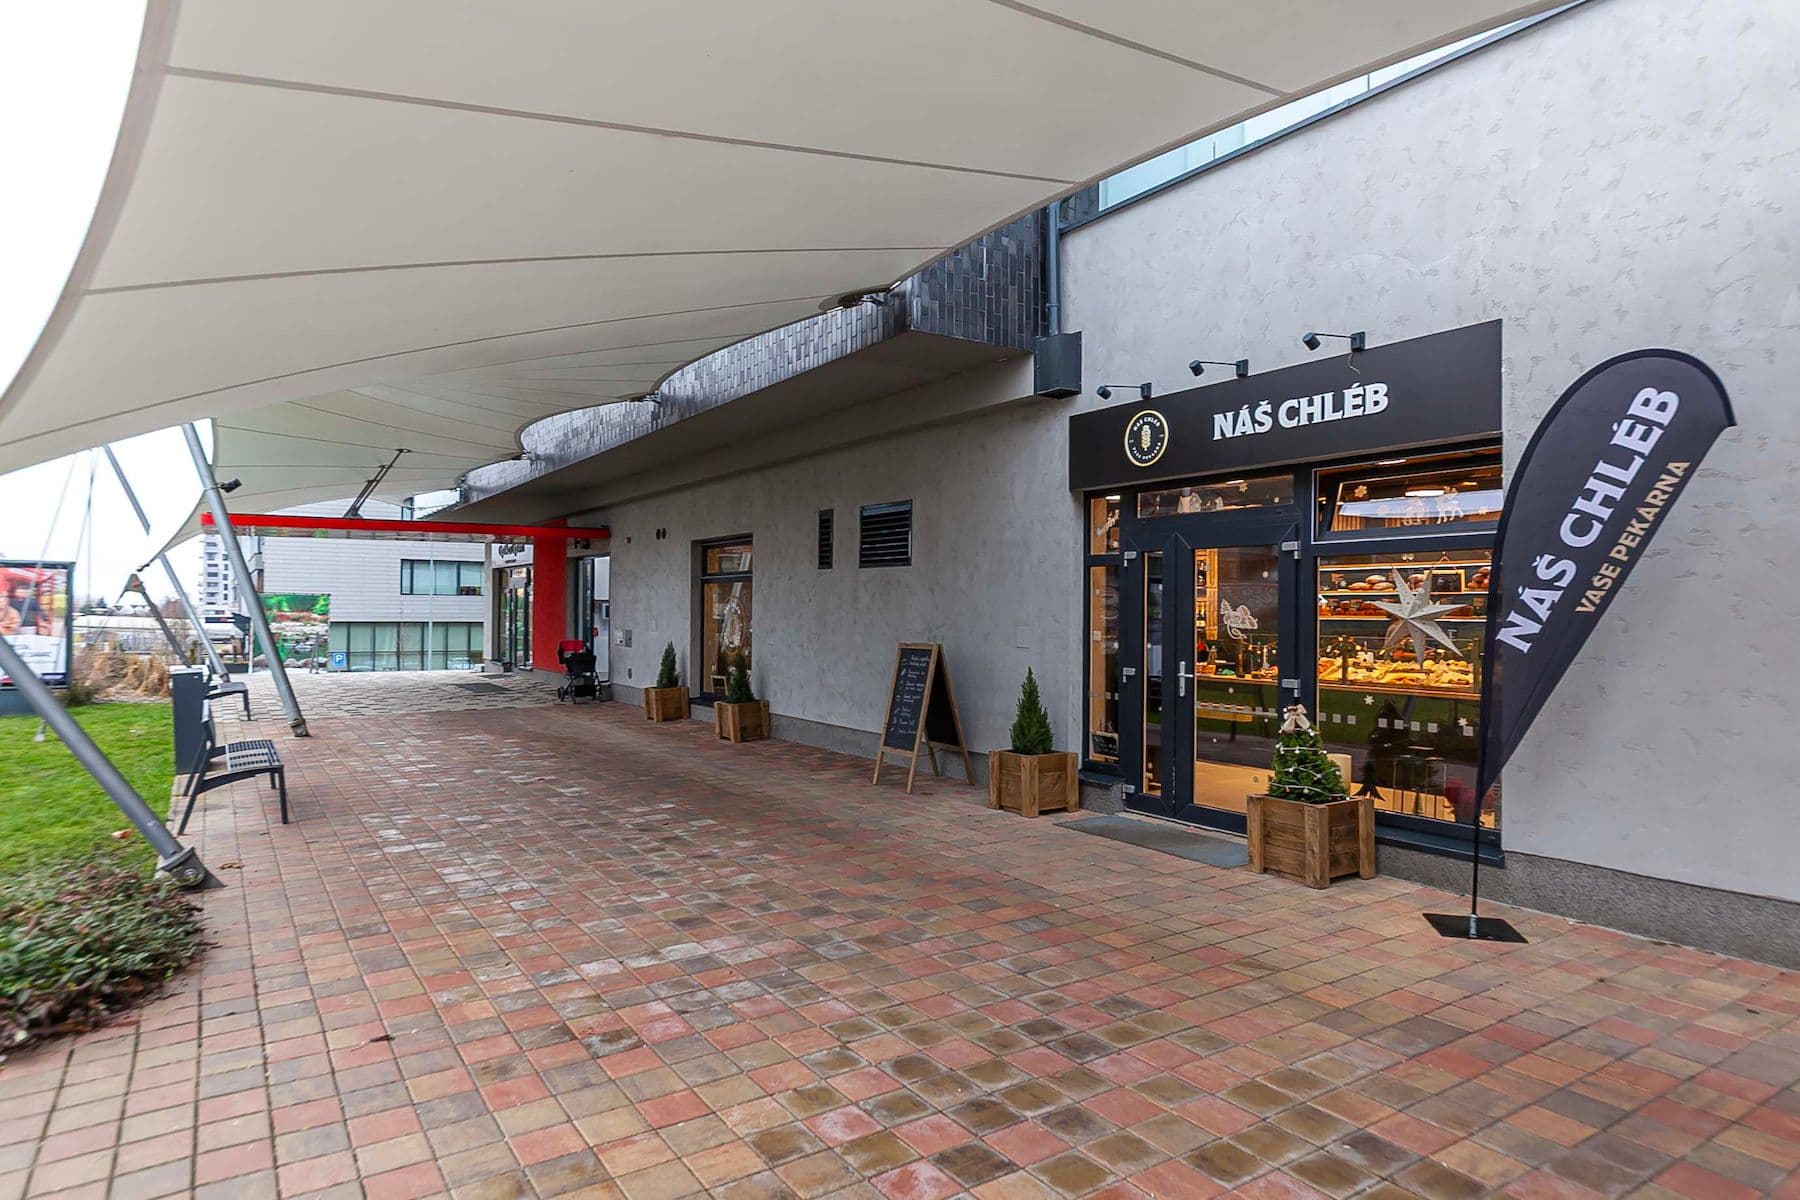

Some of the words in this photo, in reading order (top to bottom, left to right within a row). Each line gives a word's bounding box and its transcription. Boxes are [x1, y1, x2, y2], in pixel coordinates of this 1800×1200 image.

[1212, 400, 1273, 440] NÁŠ
[1278, 382, 1389, 429] CHLÉB
[1495, 554, 1577, 654] NÁŠ
[1559, 387, 1680, 548] CHLÉB
[1574, 563, 1622, 614] VAŠE
[1609, 460, 1691, 562] PEKÁRNA
